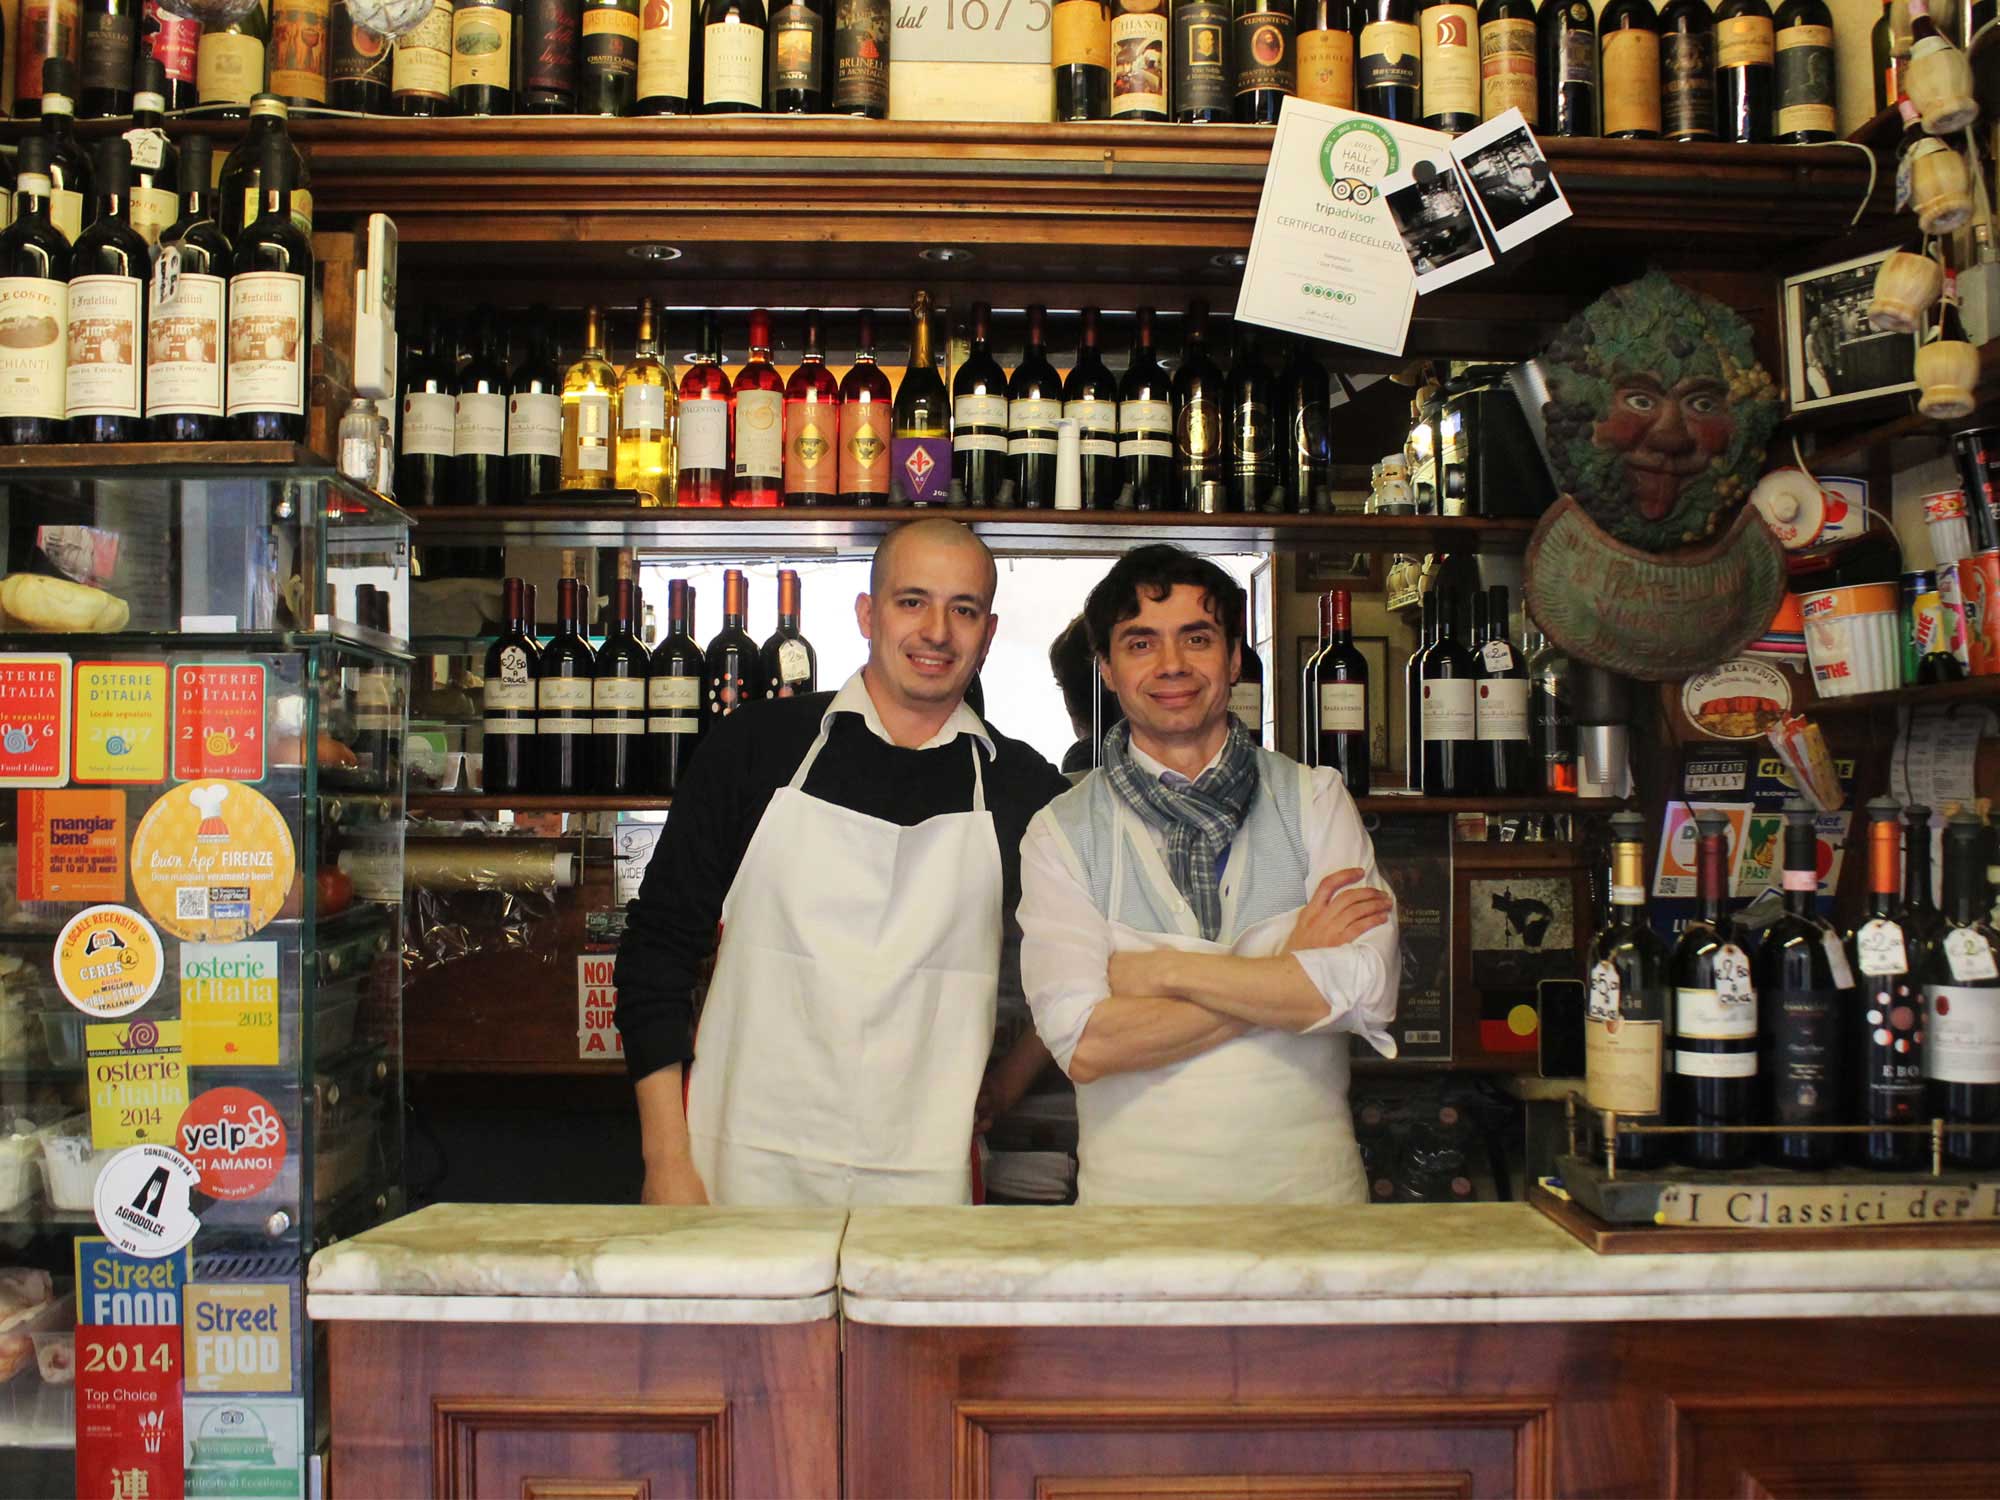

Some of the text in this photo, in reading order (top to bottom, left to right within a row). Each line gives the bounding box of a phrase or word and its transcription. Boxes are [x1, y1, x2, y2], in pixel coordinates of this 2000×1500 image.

[896, 6, 928, 29] dal
[1343, 149, 1369, 163] HALL
[1343, 161, 1371, 177] FAME
[1315, 202, 1376, 225] tripadvisor
[1276, 215, 1402, 252] CERTIFICATO di ECCELLENZ
[1813, 595, 1834, 610] THE
[1917, 612, 1934, 645] THE
[0, 670, 56, 682] TERIE
[183, 671, 257, 686] OSTERIE
[1825, 661, 1851, 679] THE
[90, 674, 152, 686] OSTERIE
[90, 689, 153, 702] D'ITALIA
[0, 723, 54, 737] 006
[1688, 762, 1745, 775] GREAT EATS
[1688, 776, 1742, 789] ITALY
[50, 816, 117, 834] mangiar
[50, 831, 89, 845] bene
[151, 849, 183, 868] Buon
[221, 851, 273, 867] FIRENZE
[66, 911, 139, 946] LOCALE RECENSITO
[79, 961, 123, 980] CERES
[185, 954, 265, 979] osterie
[101, 981, 134, 993] MIGLIOR
[185, 979, 273, 1004] d'Italia
[98, 999, 135, 1011] ITALIANO
[238, 1012, 273, 1026] 2013
[96, 1056, 180, 1083] osterie
[120, 1108, 162, 1127] 2014
[184, 1120, 247, 1153] yelp
[144, 1147, 185, 1169] CONSIGLIATO
[210, 1158, 273, 1171] AMANO!
[1726, 1191, 1886, 1223] Classici
[114, 1205, 166, 1237] AGRODOLCE
[93, 1257, 176, 1289] Street
[94, 1291, 177, 1325] FOOD
[196, 1302, 278, 1332] Street
[83, 1342, 173, 1373] 2014
[196, 1334, 281, 1374] FOOD
[84, 1388, 157, 1403] Top Choice
